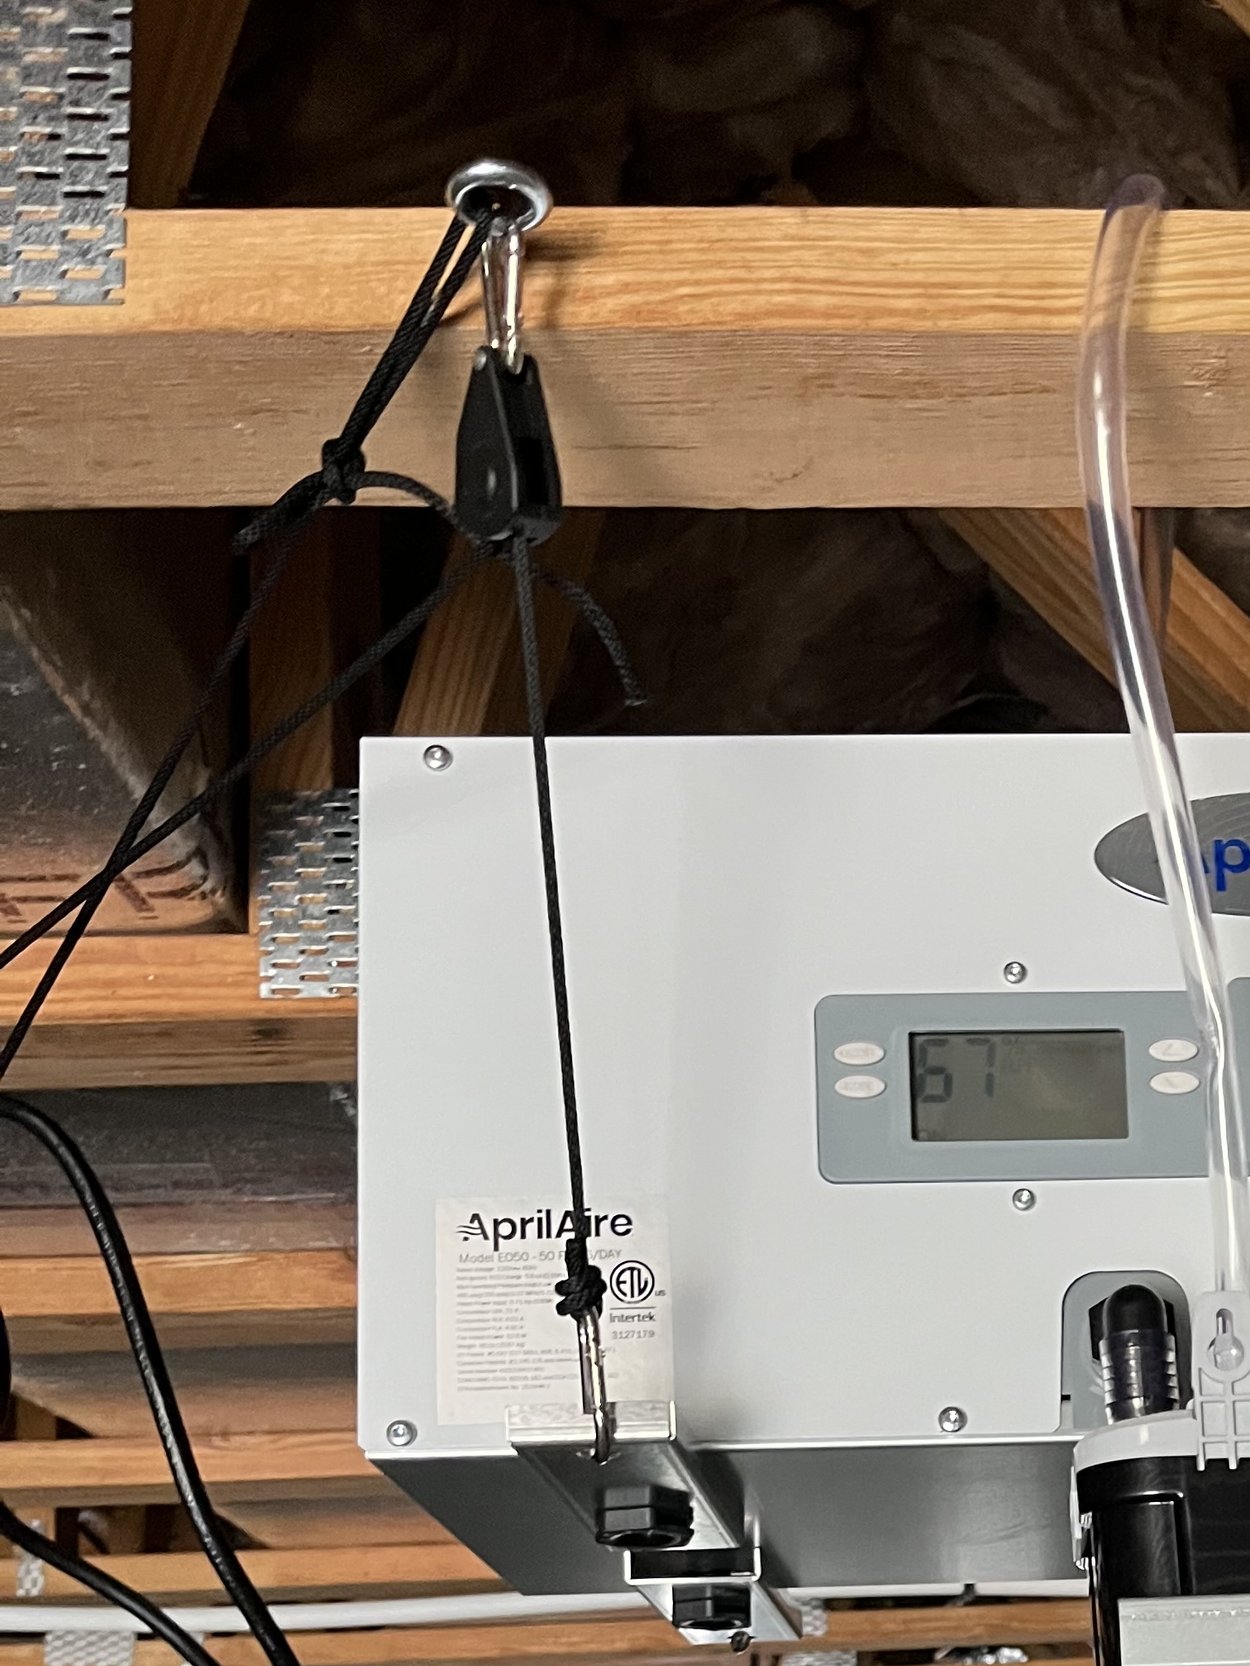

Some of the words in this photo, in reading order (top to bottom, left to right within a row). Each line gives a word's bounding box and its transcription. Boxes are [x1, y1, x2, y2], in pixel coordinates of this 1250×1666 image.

[917, 1037, 996, 1104] 67
[459, 1252, 494, 1263] Model
[539, 1250, 555, 1261] 50
[614, 1265, 650, 1299] ETL
[610, 1312, 656, 1323] Intertek
